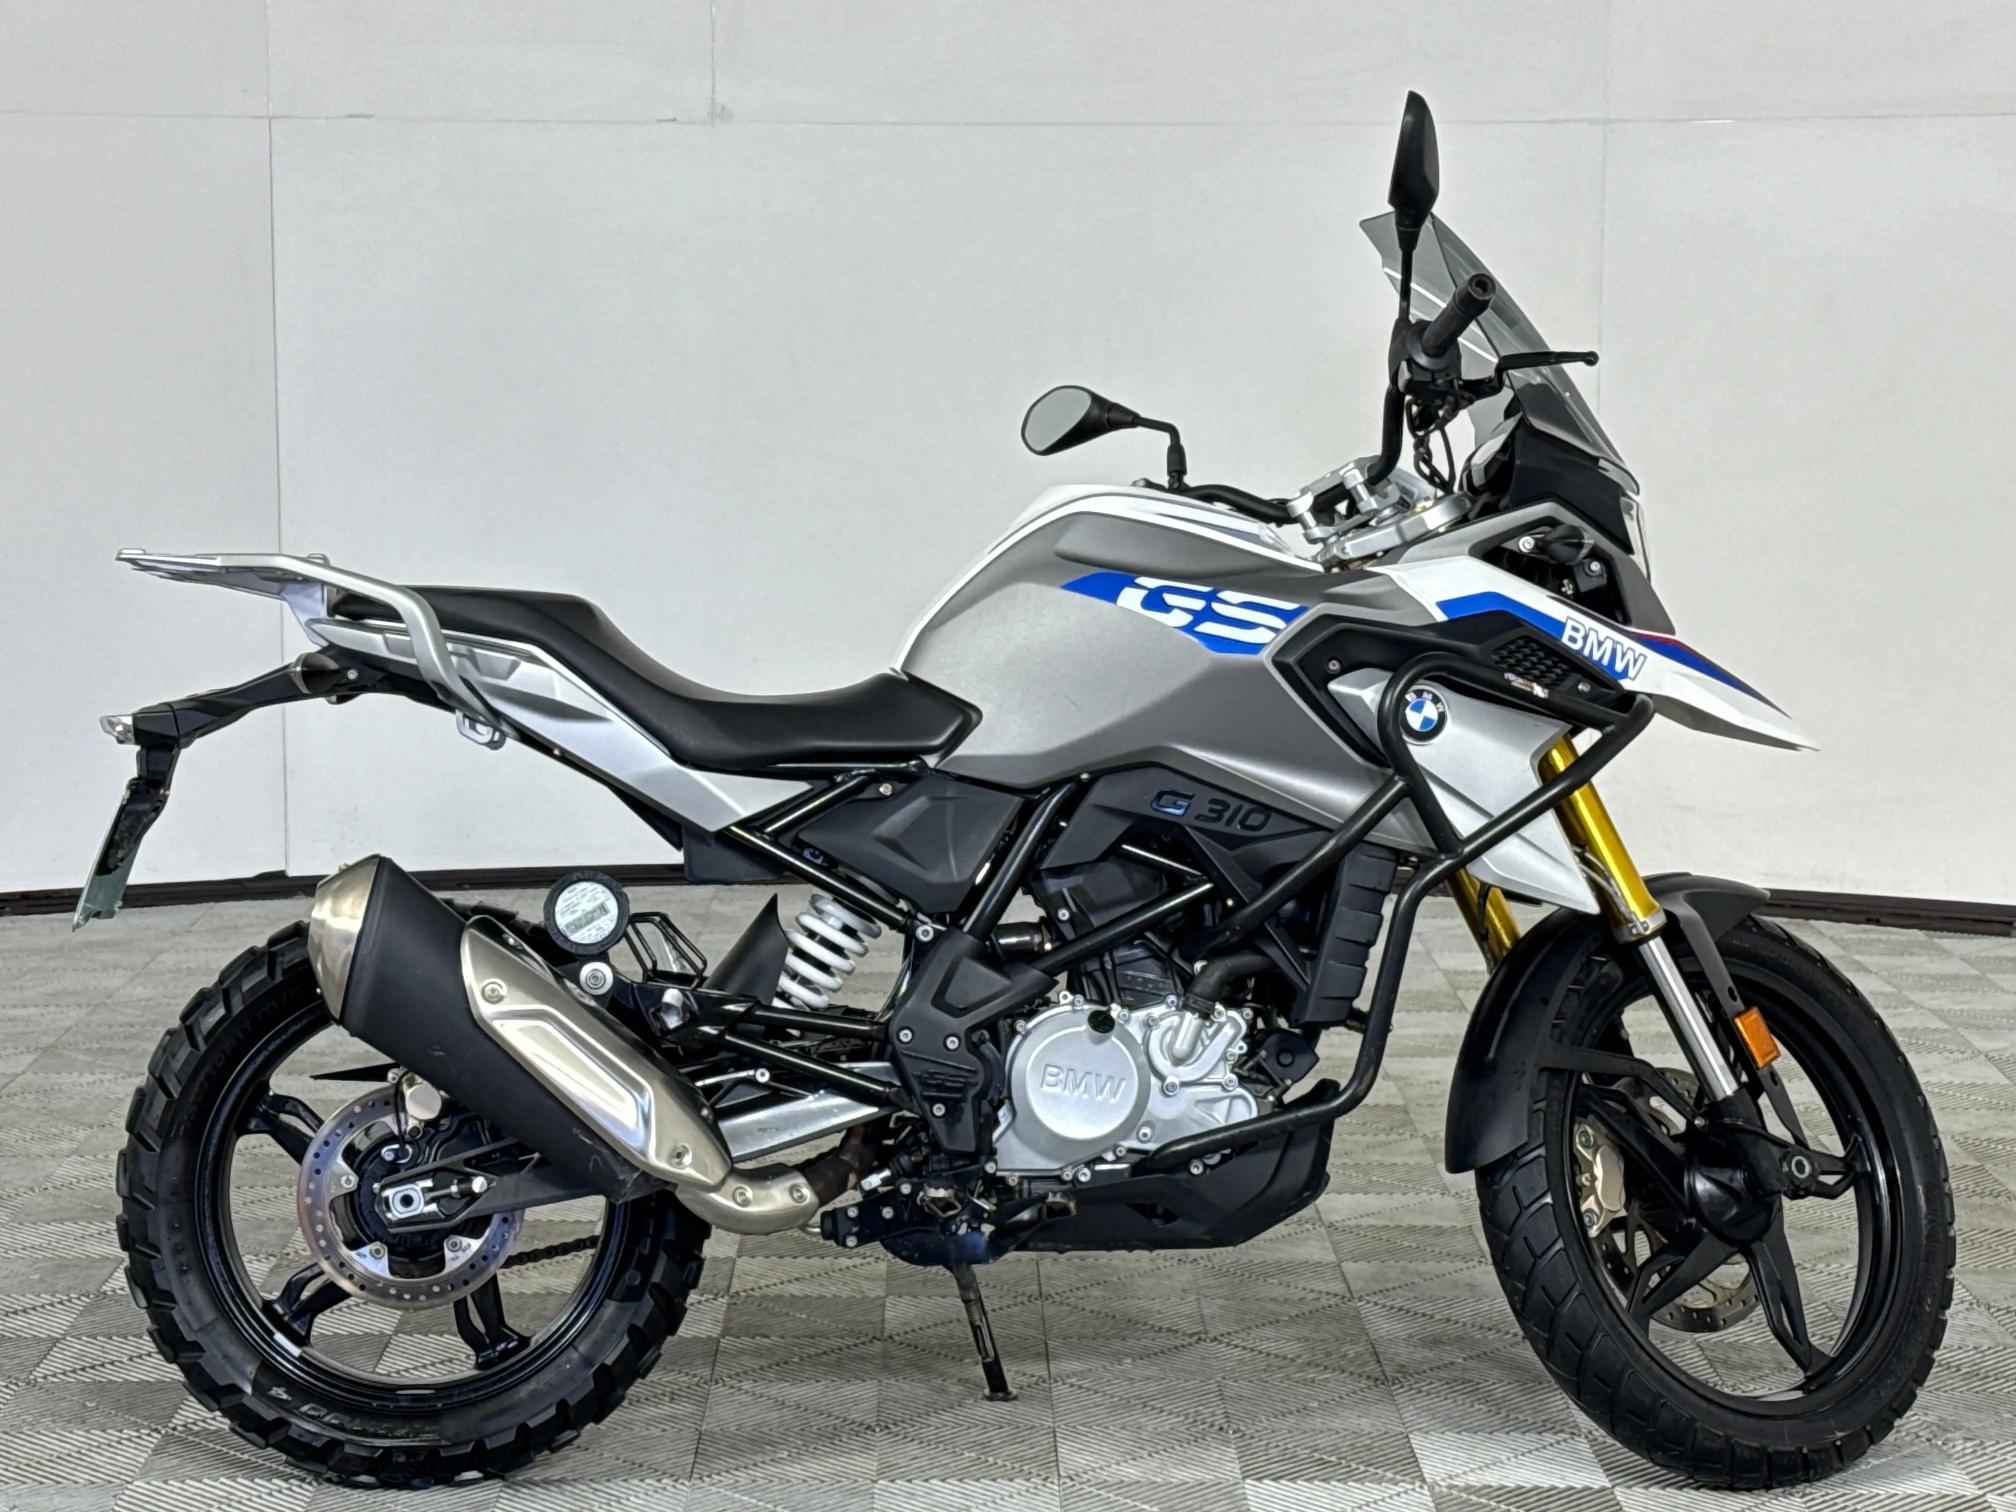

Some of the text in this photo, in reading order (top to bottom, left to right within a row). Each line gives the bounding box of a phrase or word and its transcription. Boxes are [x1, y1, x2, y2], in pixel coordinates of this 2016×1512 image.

[1116, 576, 1301, 644] GS
[1561, 615, 1648, 681] BMW
[1404, 691, 1446, 713] BMW
[1150, 789, 1273, 832] G 310
[1040, 1063, 1126, 1104] BMW
